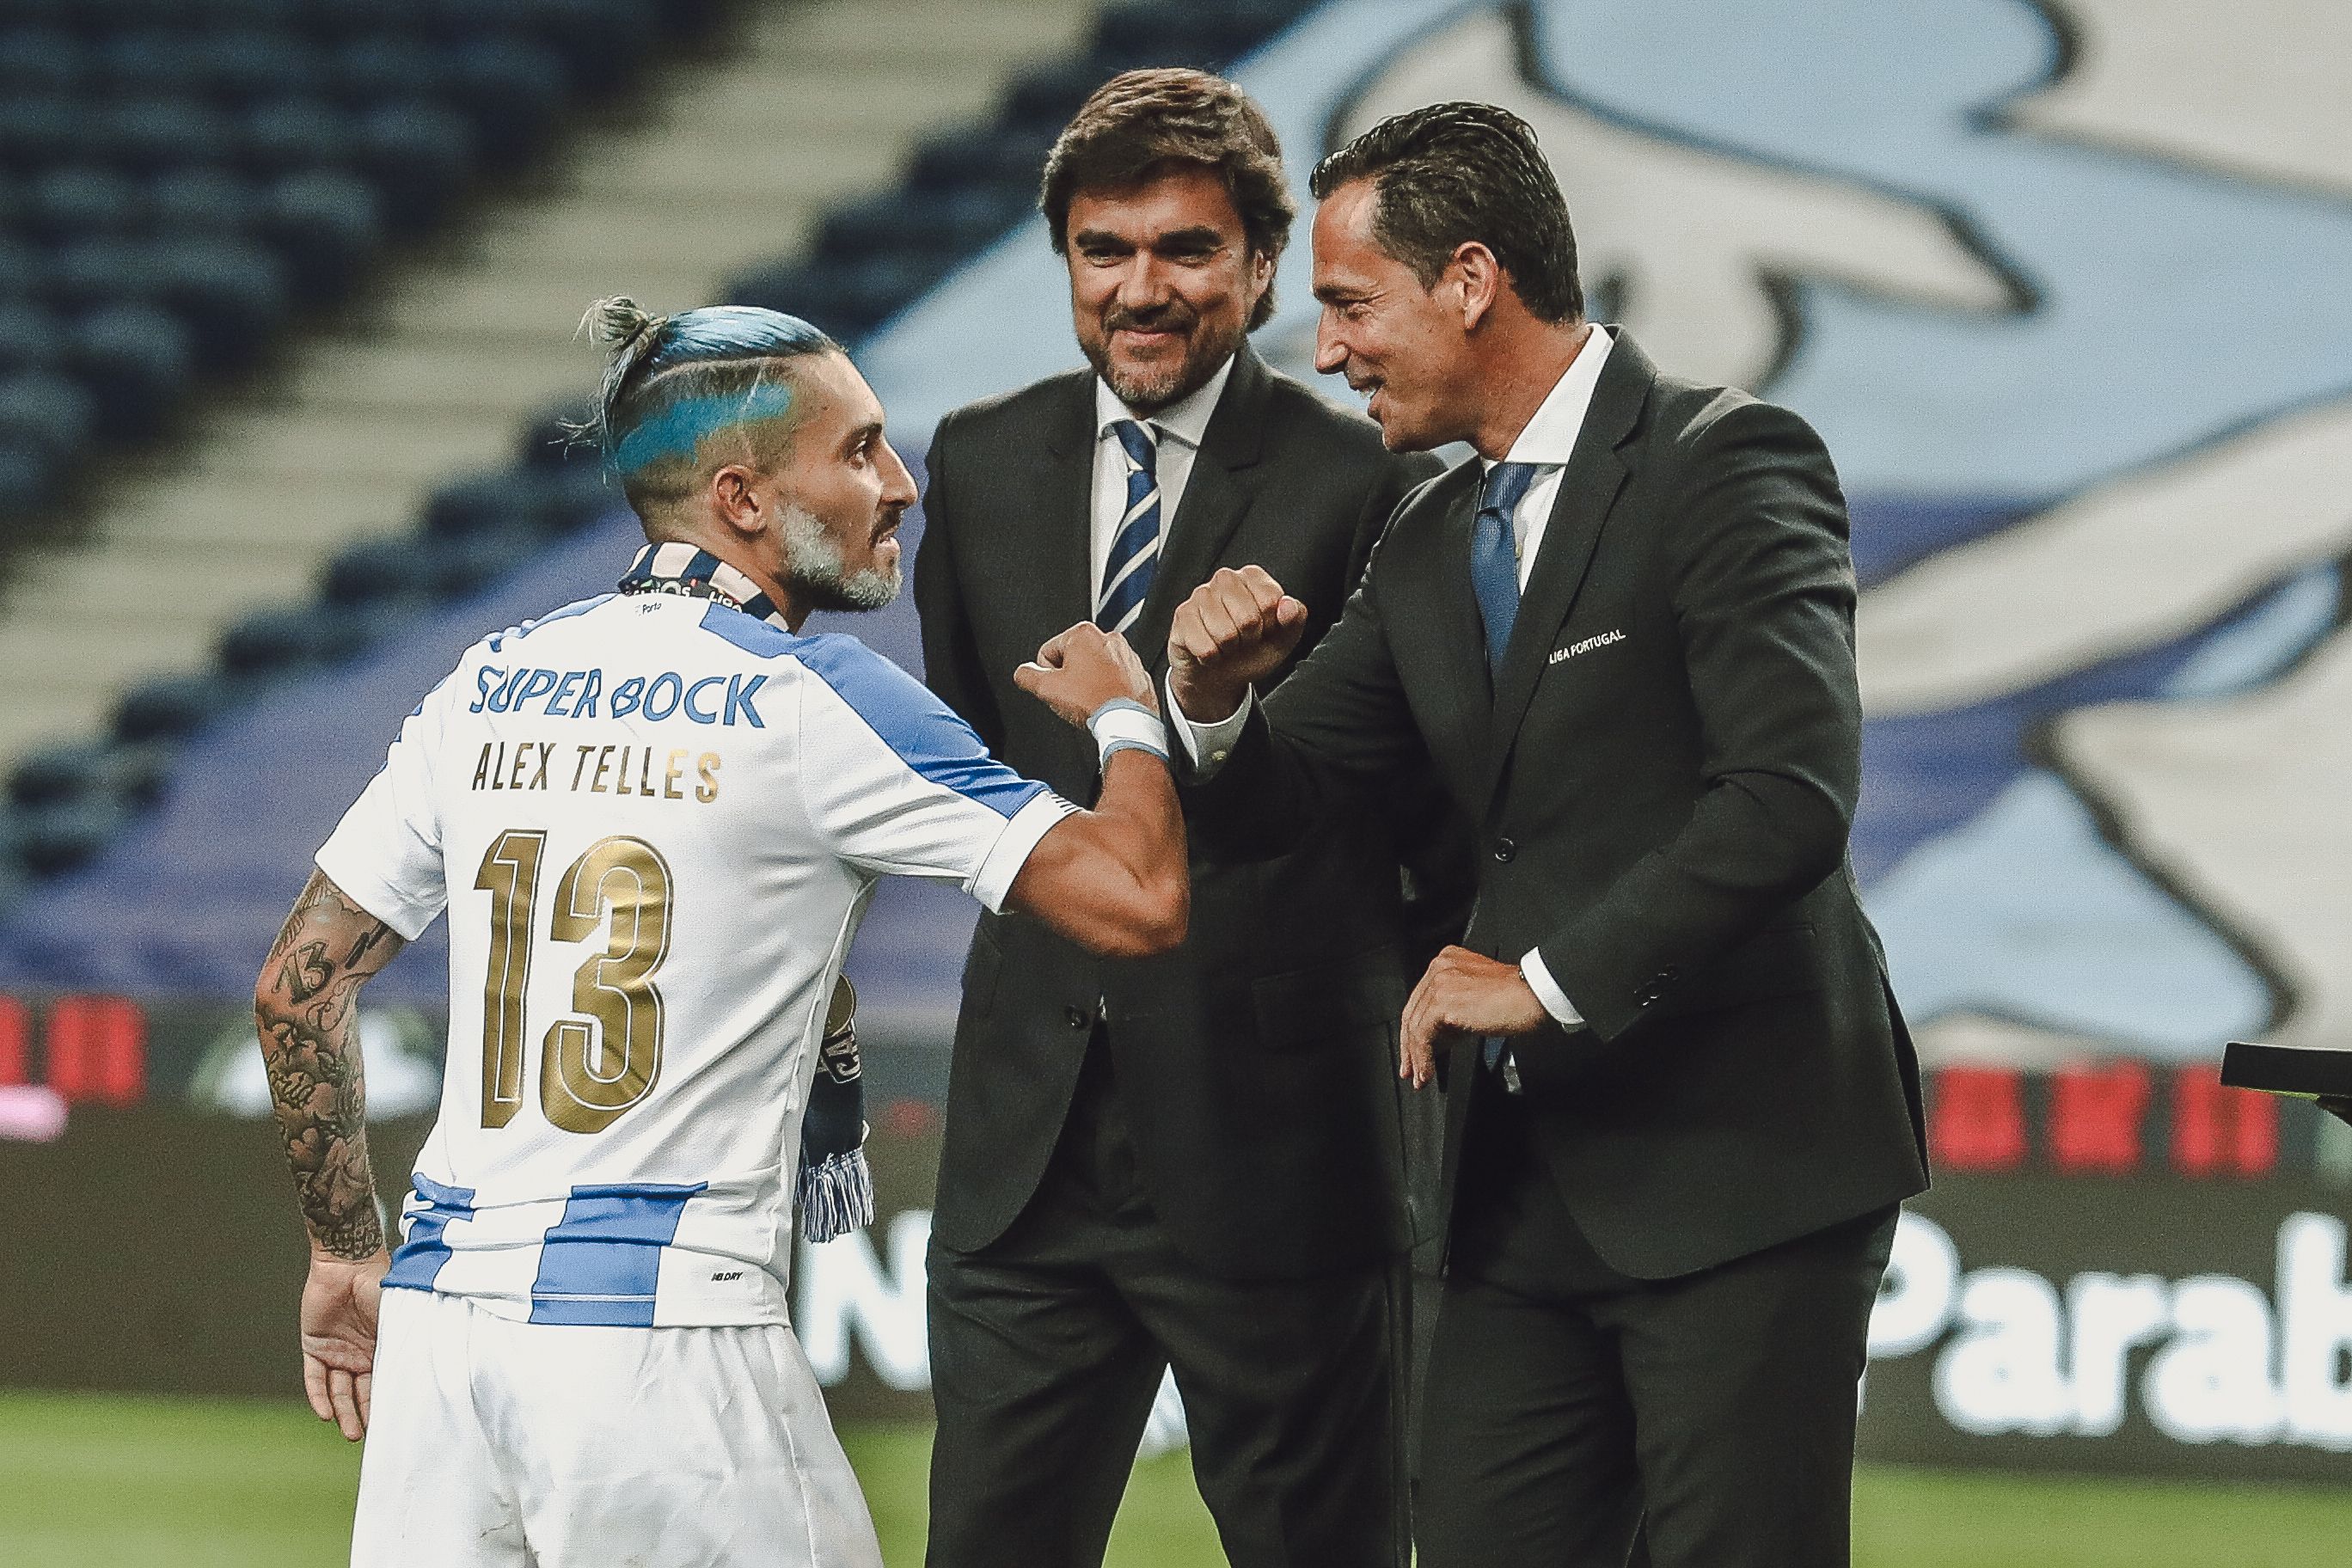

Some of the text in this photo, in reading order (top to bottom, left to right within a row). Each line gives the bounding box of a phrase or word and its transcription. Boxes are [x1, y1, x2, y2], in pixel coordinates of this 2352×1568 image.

[1549, 629, 1626, 664] LIGA PORTUGAL
[469, 665, 769, 729] SUPER BOCK
[472, 741, 721, 803] ALEX TELLES
[474, 828, 673, 1134] 13
[724, 1272, 744, 1281] DRY
